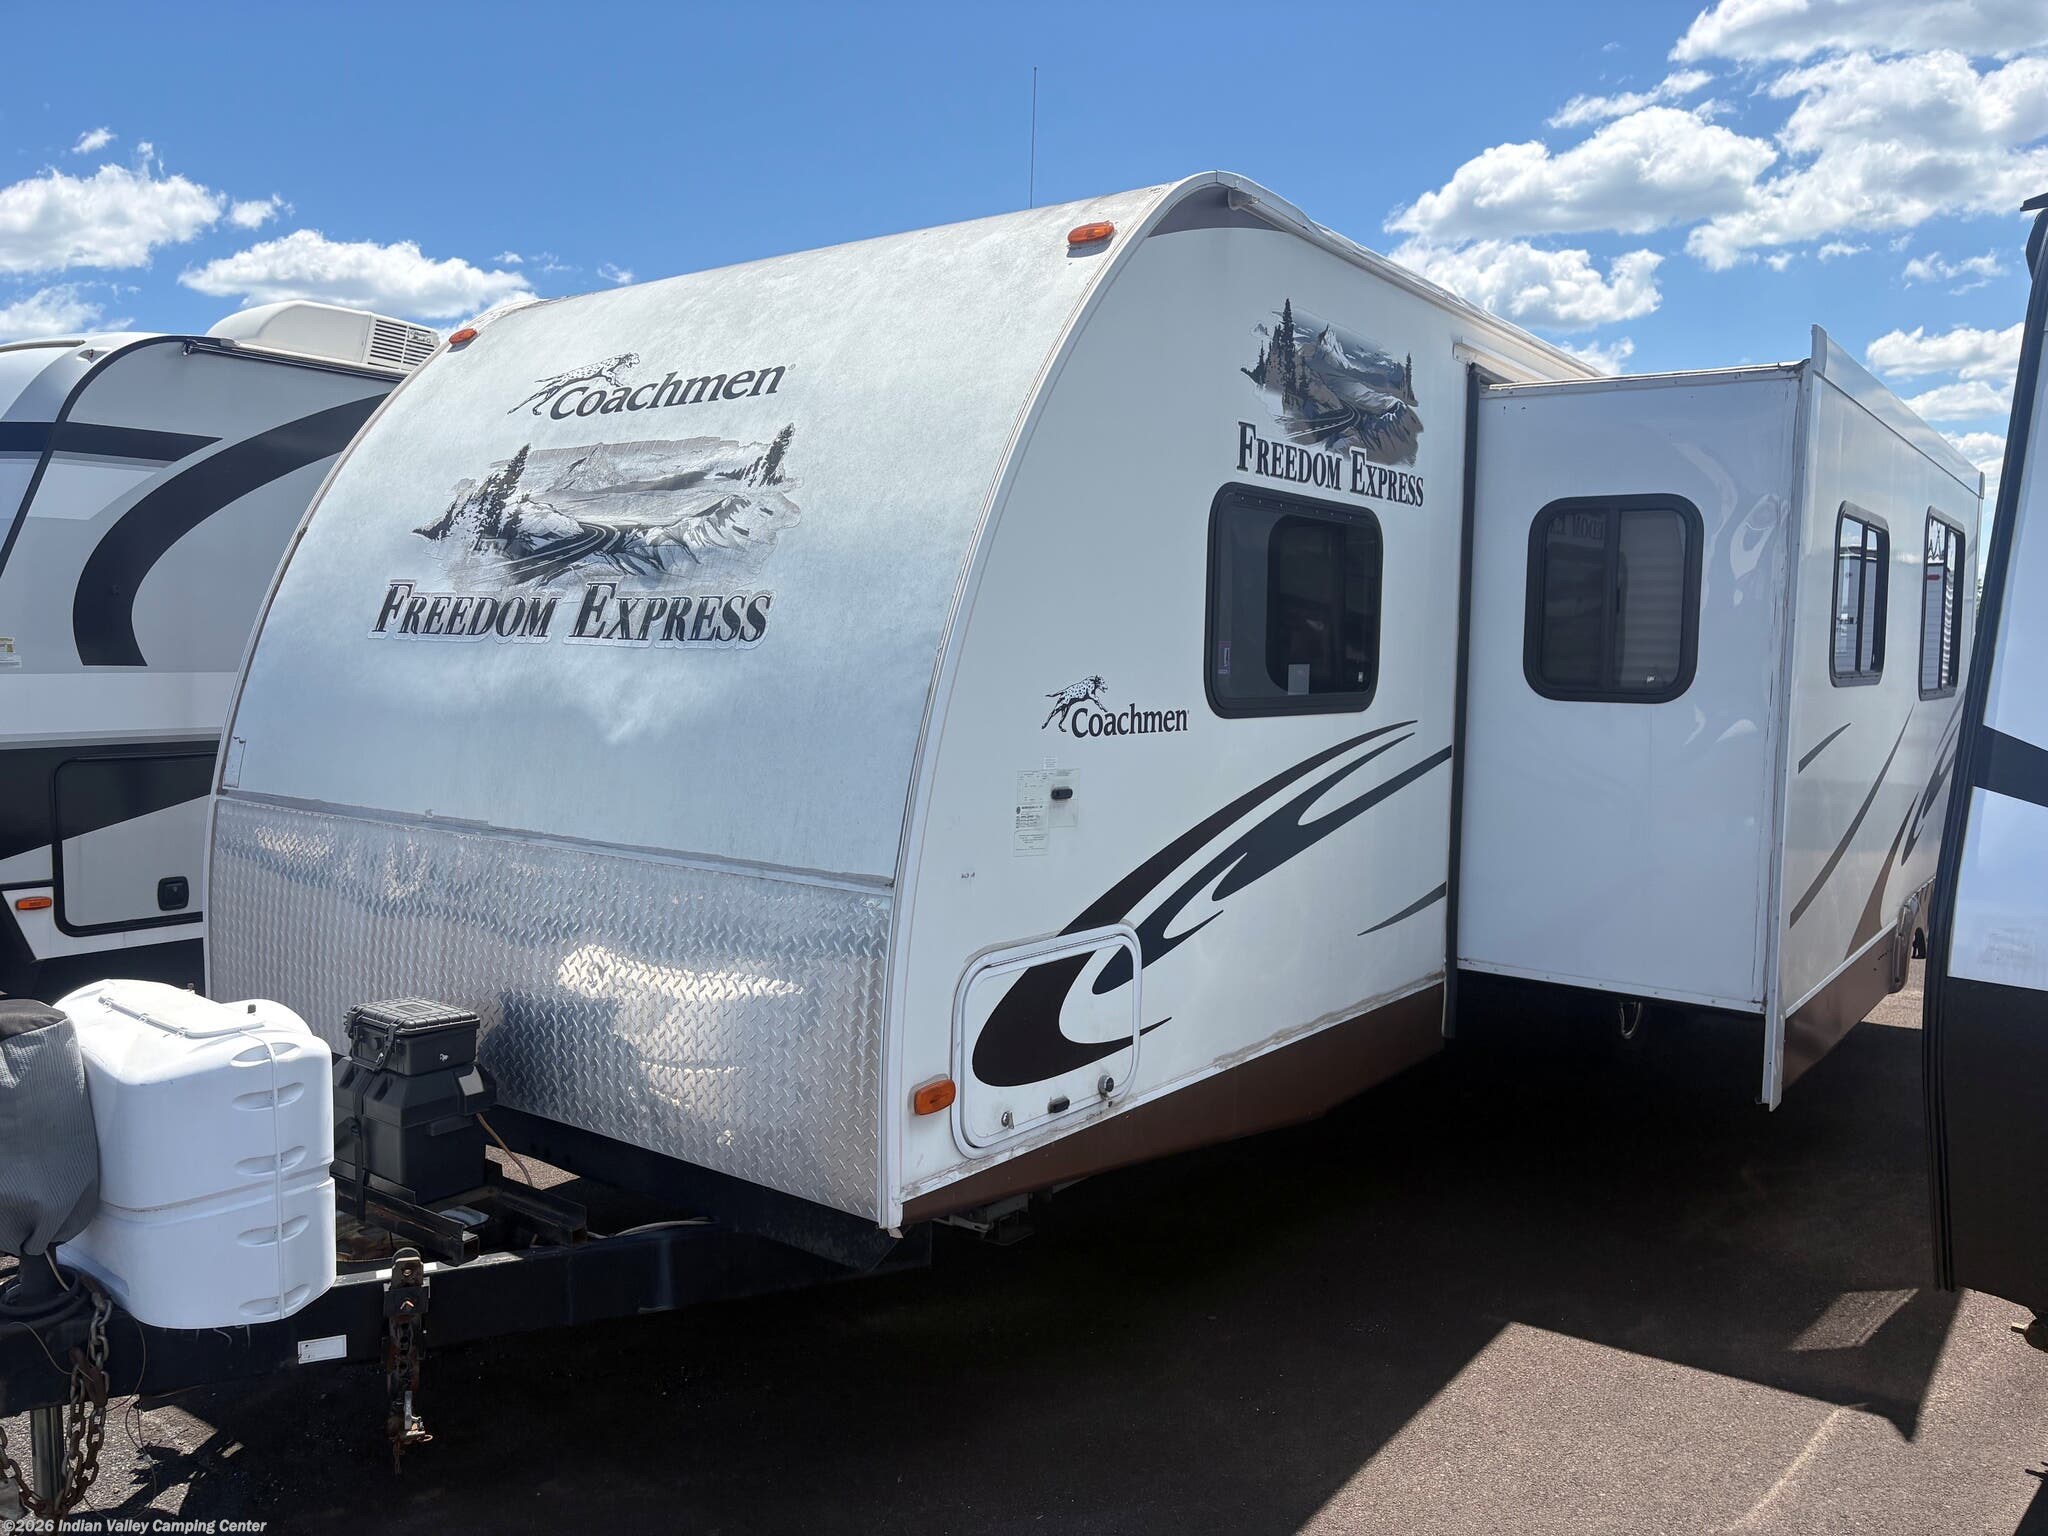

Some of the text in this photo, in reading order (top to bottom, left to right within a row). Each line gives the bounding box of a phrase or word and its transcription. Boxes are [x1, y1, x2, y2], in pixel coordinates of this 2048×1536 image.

[549, 364, 787, 420] Coachmen
[1236, 421, 1424, 508] FREEDOM EXPRESS
[371, 582, 774, 642] FREEDOM EXPRESS
[1071, 702, 1189, 738] Coachmen
